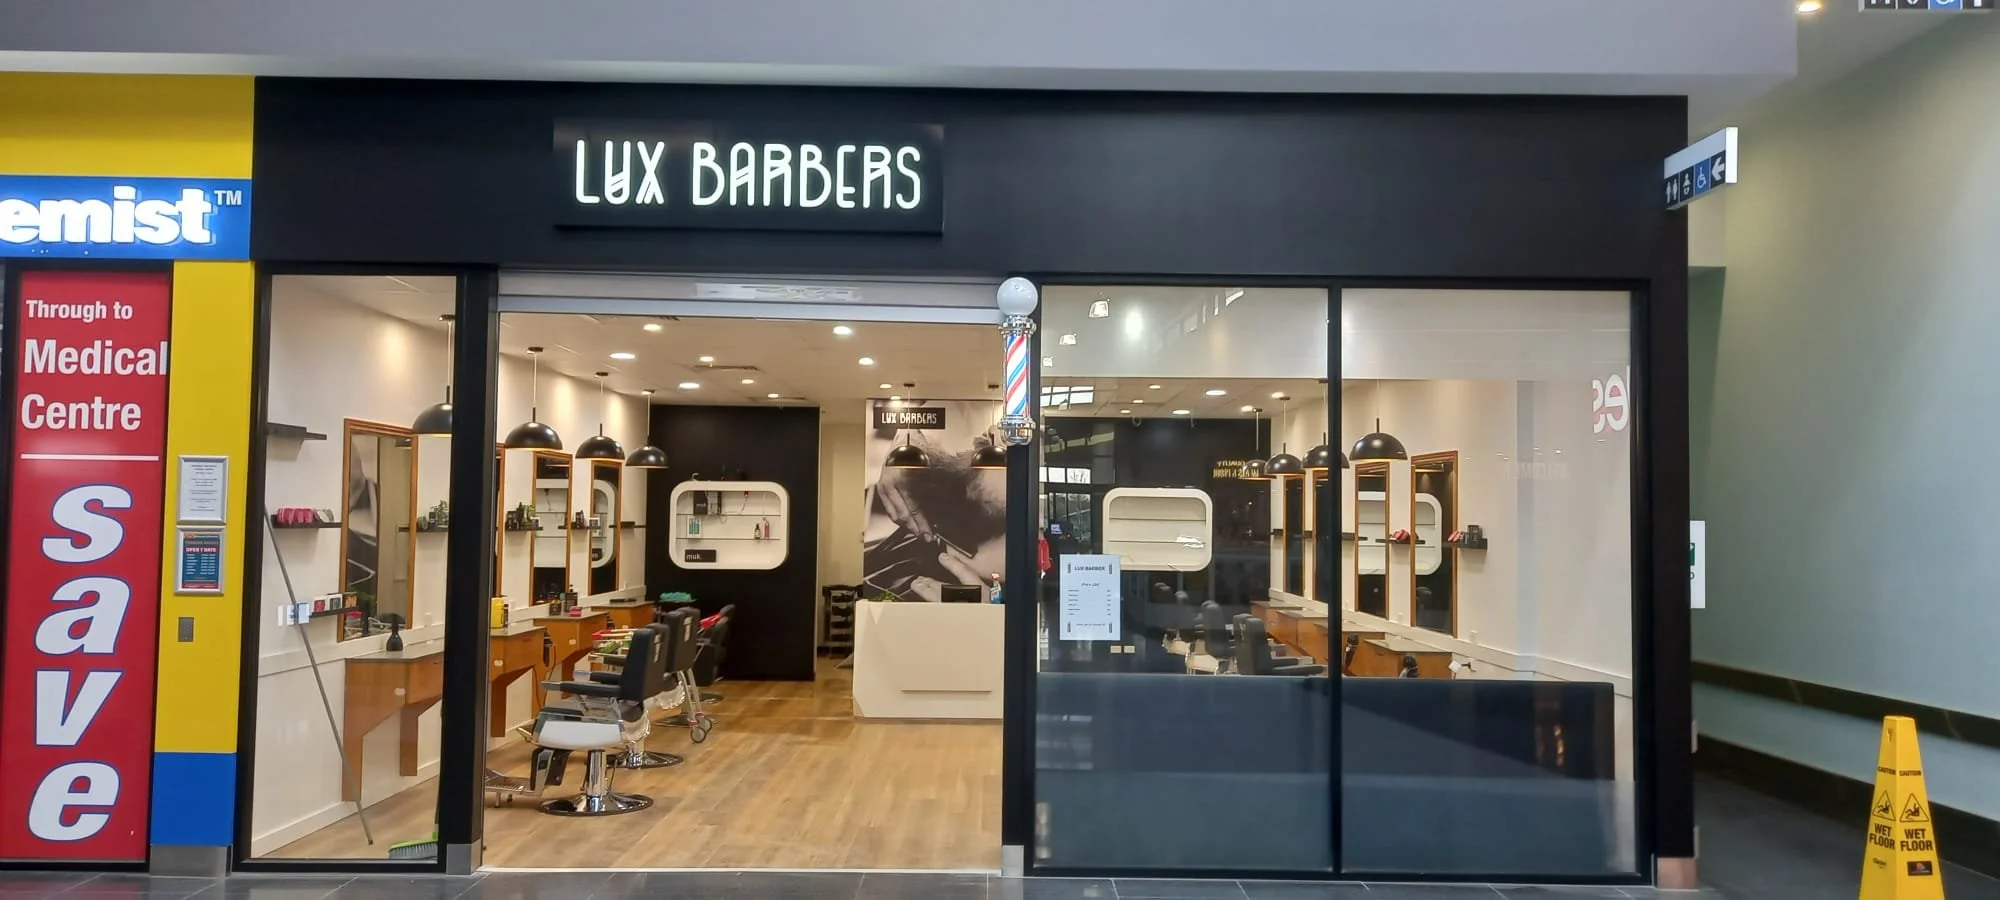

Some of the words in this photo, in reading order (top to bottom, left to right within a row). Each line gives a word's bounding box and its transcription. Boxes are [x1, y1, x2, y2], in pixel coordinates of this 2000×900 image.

[575, 139, 665, 205] LUX
[691, 141, 922, 210] BARBERS
[0, 185, 212, 244] emist
[26, 300, 106, 322] Through
[113, 301, 133, 320] to
[23, 339, 168, 376] Medical
[21, 394, 141, 430] Centre
[881, 412, 897, 424] LUX
[899, 412, 937, 424] BARBERS
[28, 484, 134, 842] save
[1878, 766, 1896, 776] CAUTION
[1874, 823, 1892, 837] WET
[1904, 828, 1926, 840] WET
[1869, 834, 1895, 850] FLOOR
[1900, 840, 1933, 852] FLOOR
